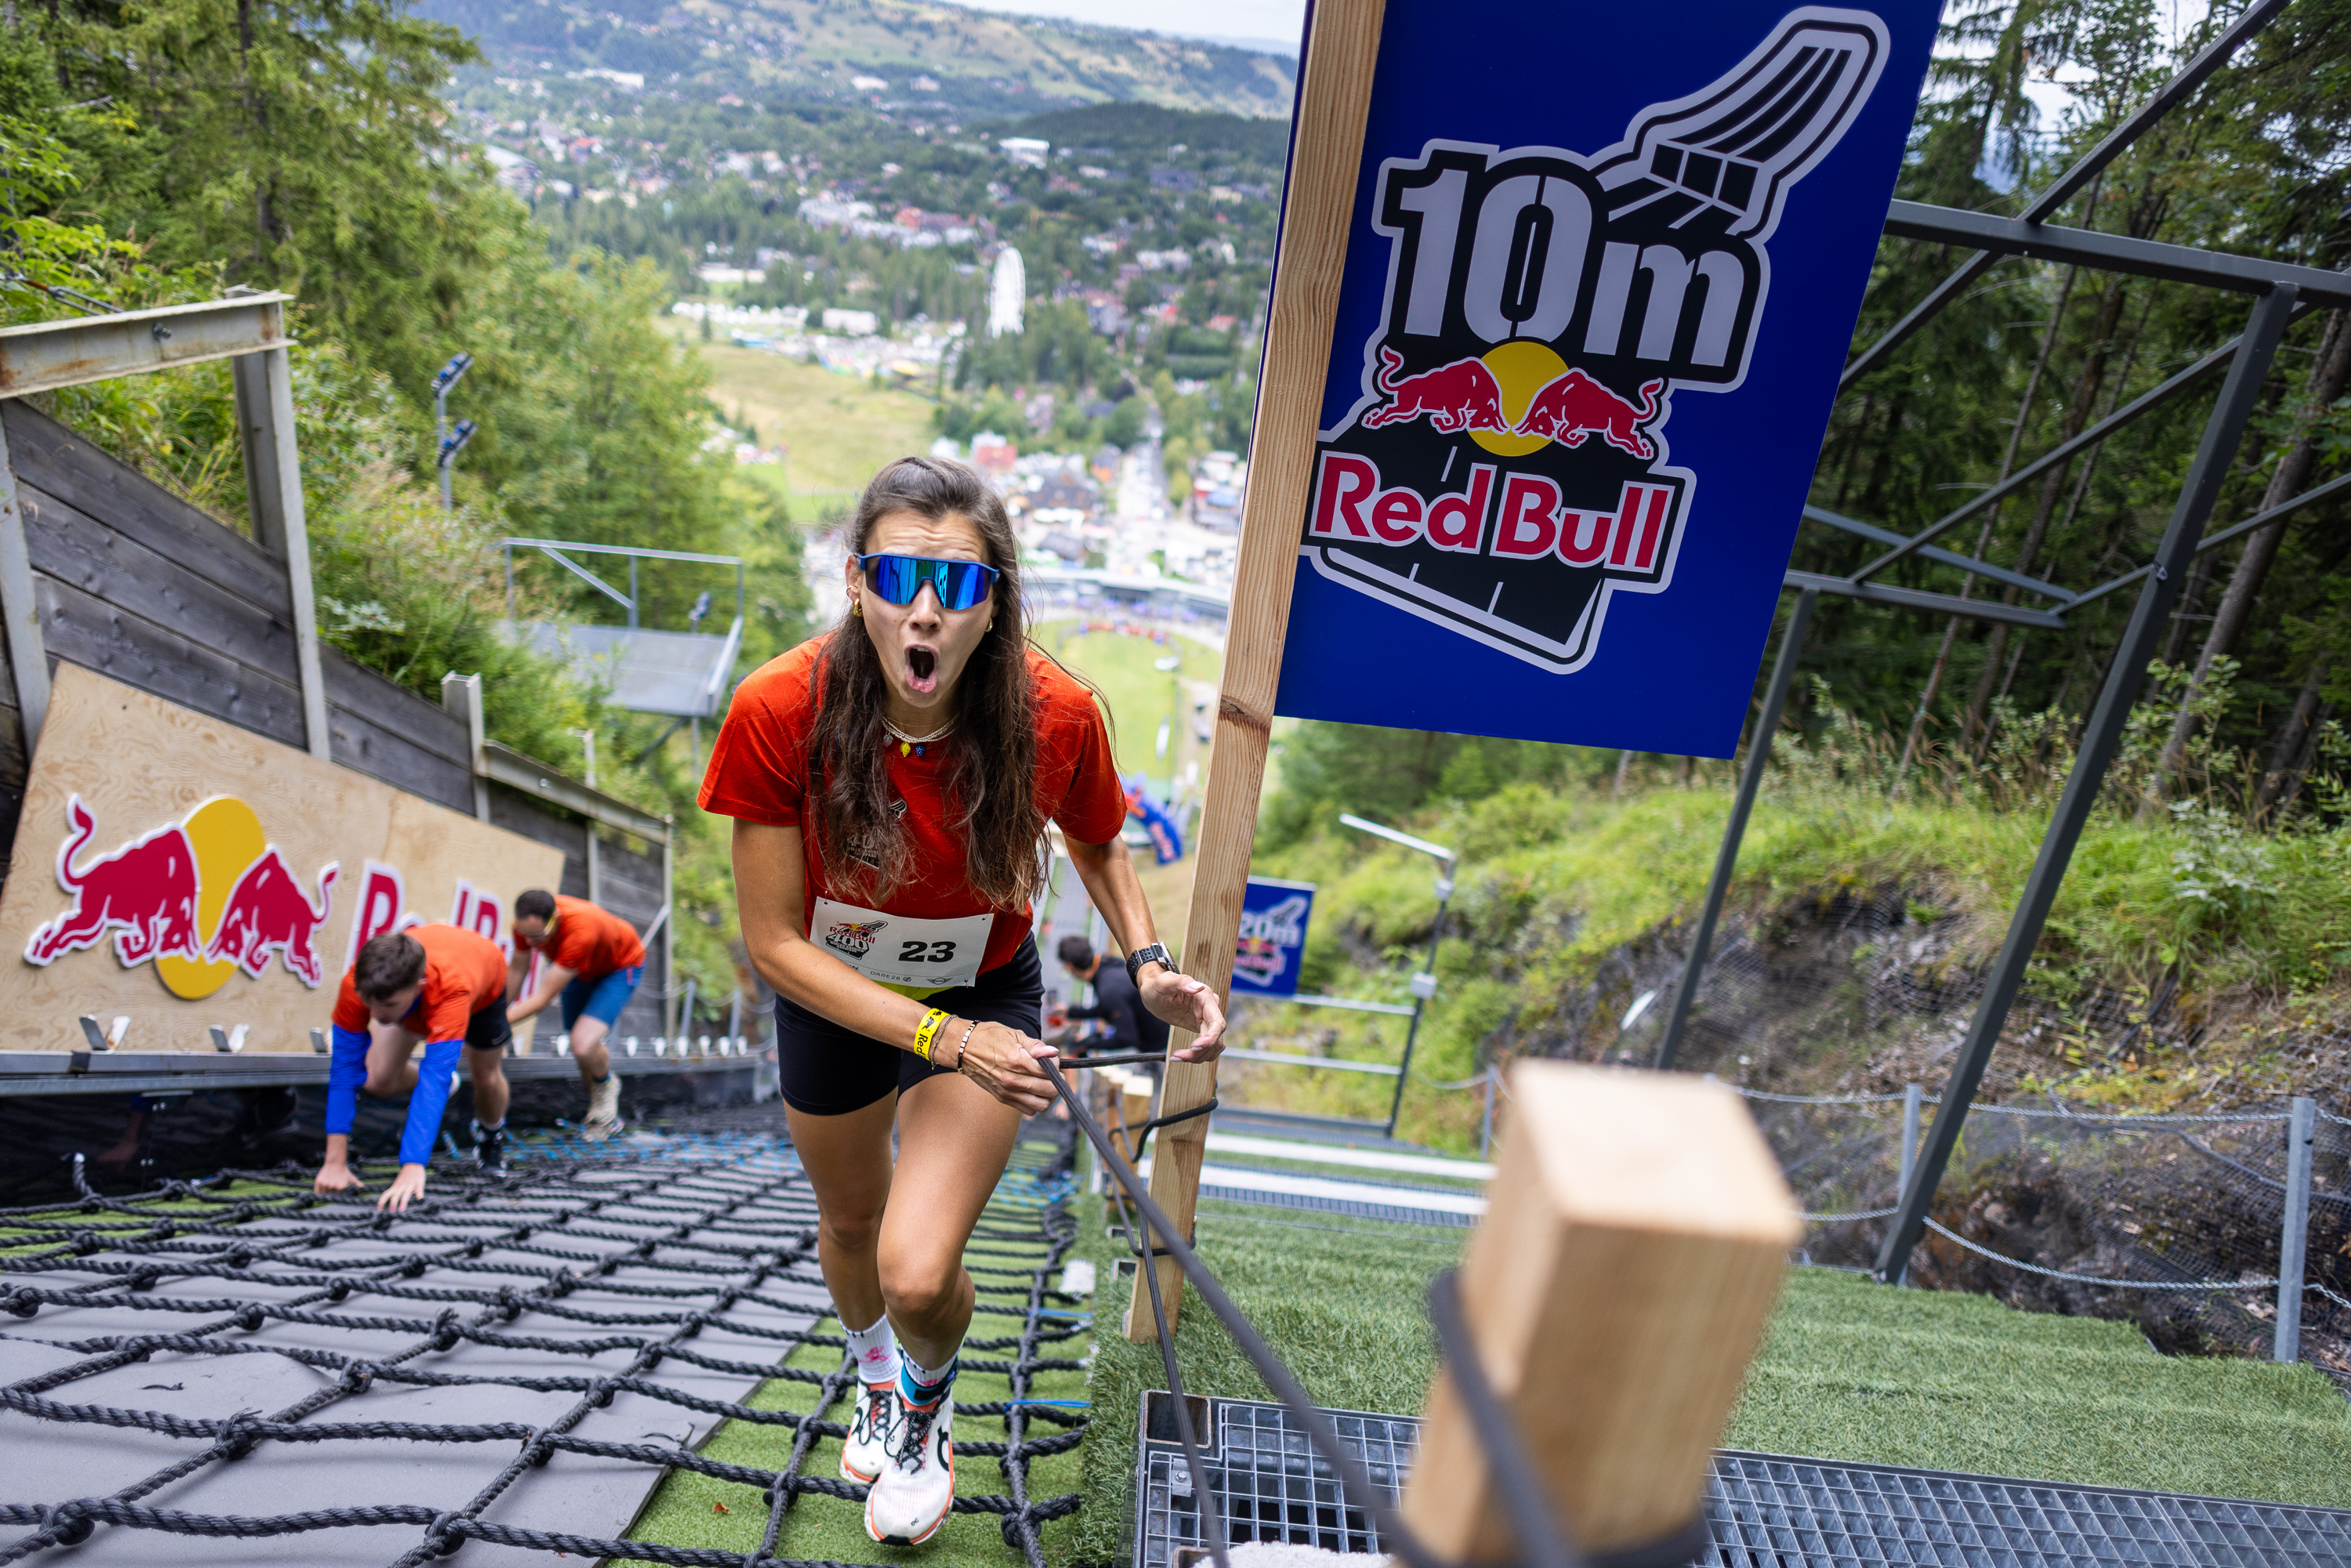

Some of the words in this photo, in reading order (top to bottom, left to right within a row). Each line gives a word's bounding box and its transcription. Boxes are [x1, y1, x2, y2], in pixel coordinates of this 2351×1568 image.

[1400, 168, 1744, 368] 10m
[1314, 455, 1492, 549] Red
[1495, 476, 1669, 569] Bull
[829, 926, 852, 938] Red
[853, 932, 875, 944] Bull
[898, 940, 957, 963] 23
[917, 1034, 928, 1056] Red
